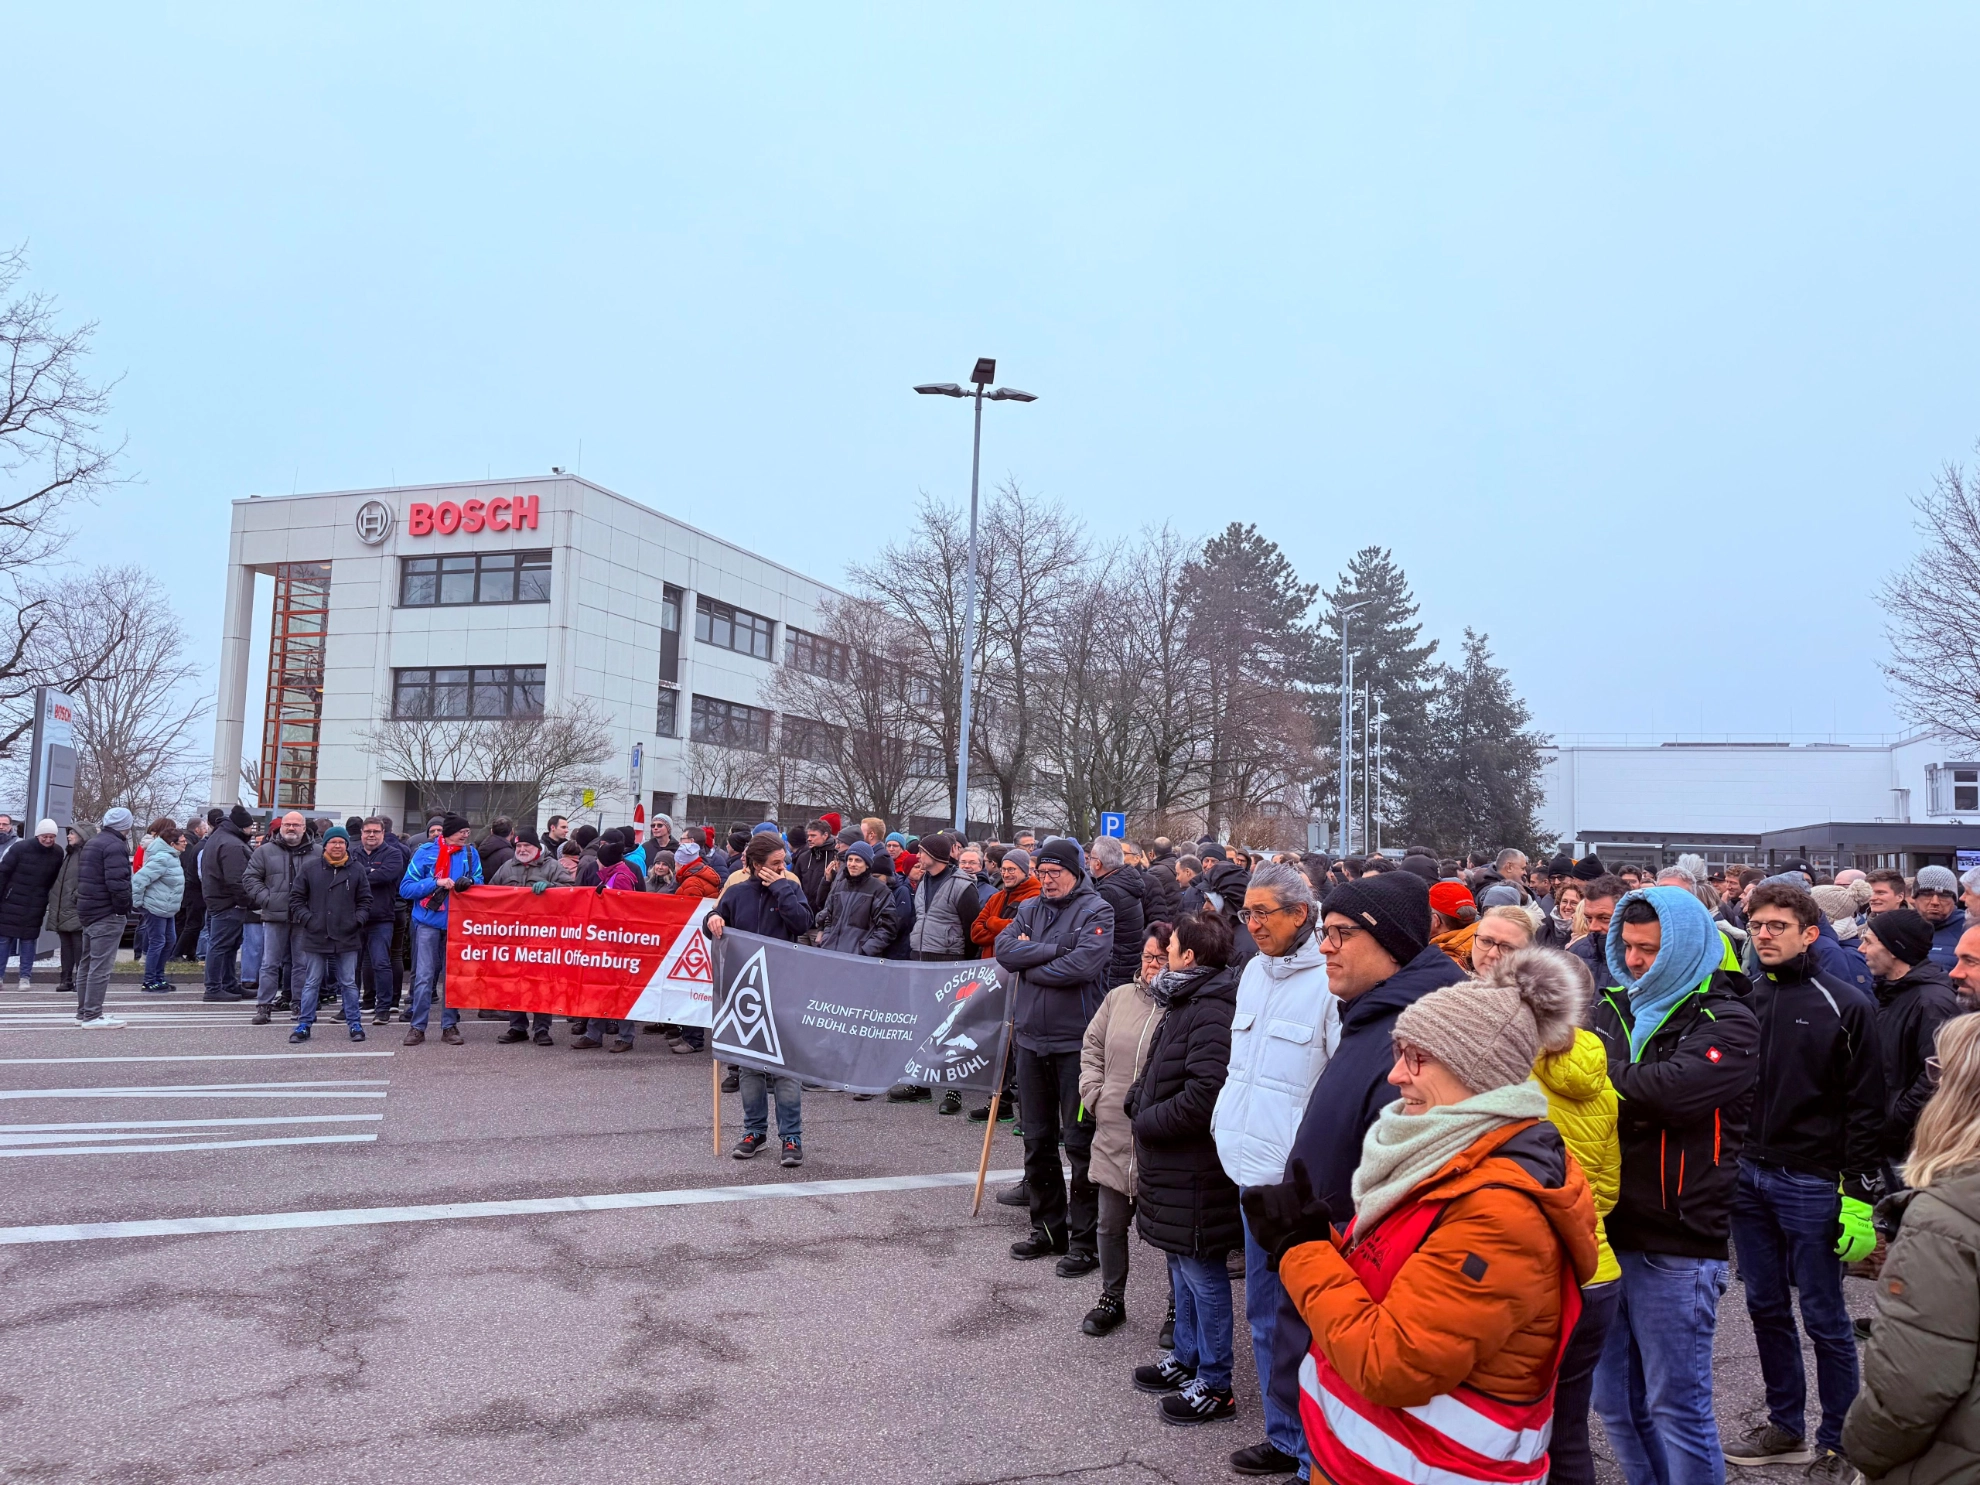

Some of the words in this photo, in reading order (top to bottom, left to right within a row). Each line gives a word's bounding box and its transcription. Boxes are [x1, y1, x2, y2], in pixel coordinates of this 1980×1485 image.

[409, 494, 539, 537] BOSCH
[54, 703, 72, 723] BOSCH
[1107, 816, 1120, 837] P
[462, 919, 557, 939] Seniorinnen
[560, 924, 582, 940] und
[585, 924, 660, 947] Senioren
[460, 944, 488, 961] der
[492, 946, 509, 962] IG
[514, 947, 561, 965] Metall
[564, 949, 641, 974] Offenburg
[935, 967, 977, 1002] BOSCH
[807, 999, 862, 1019] ZUKUNFT
[862, 1009, 884, 1023] FÜR
[884, 1012, 918, 1025] BOSCH
[801, 1015, 815, 1026] IN
[816, 1017, 847, 1034] BÜHL
[849, 1024, 858, 1036] &
[859, 1025, 913, 1041] BÜHLERTAL
[923, 1068, 941, 1083] IN
[946, 1055, 990, 1082] BÜHL
